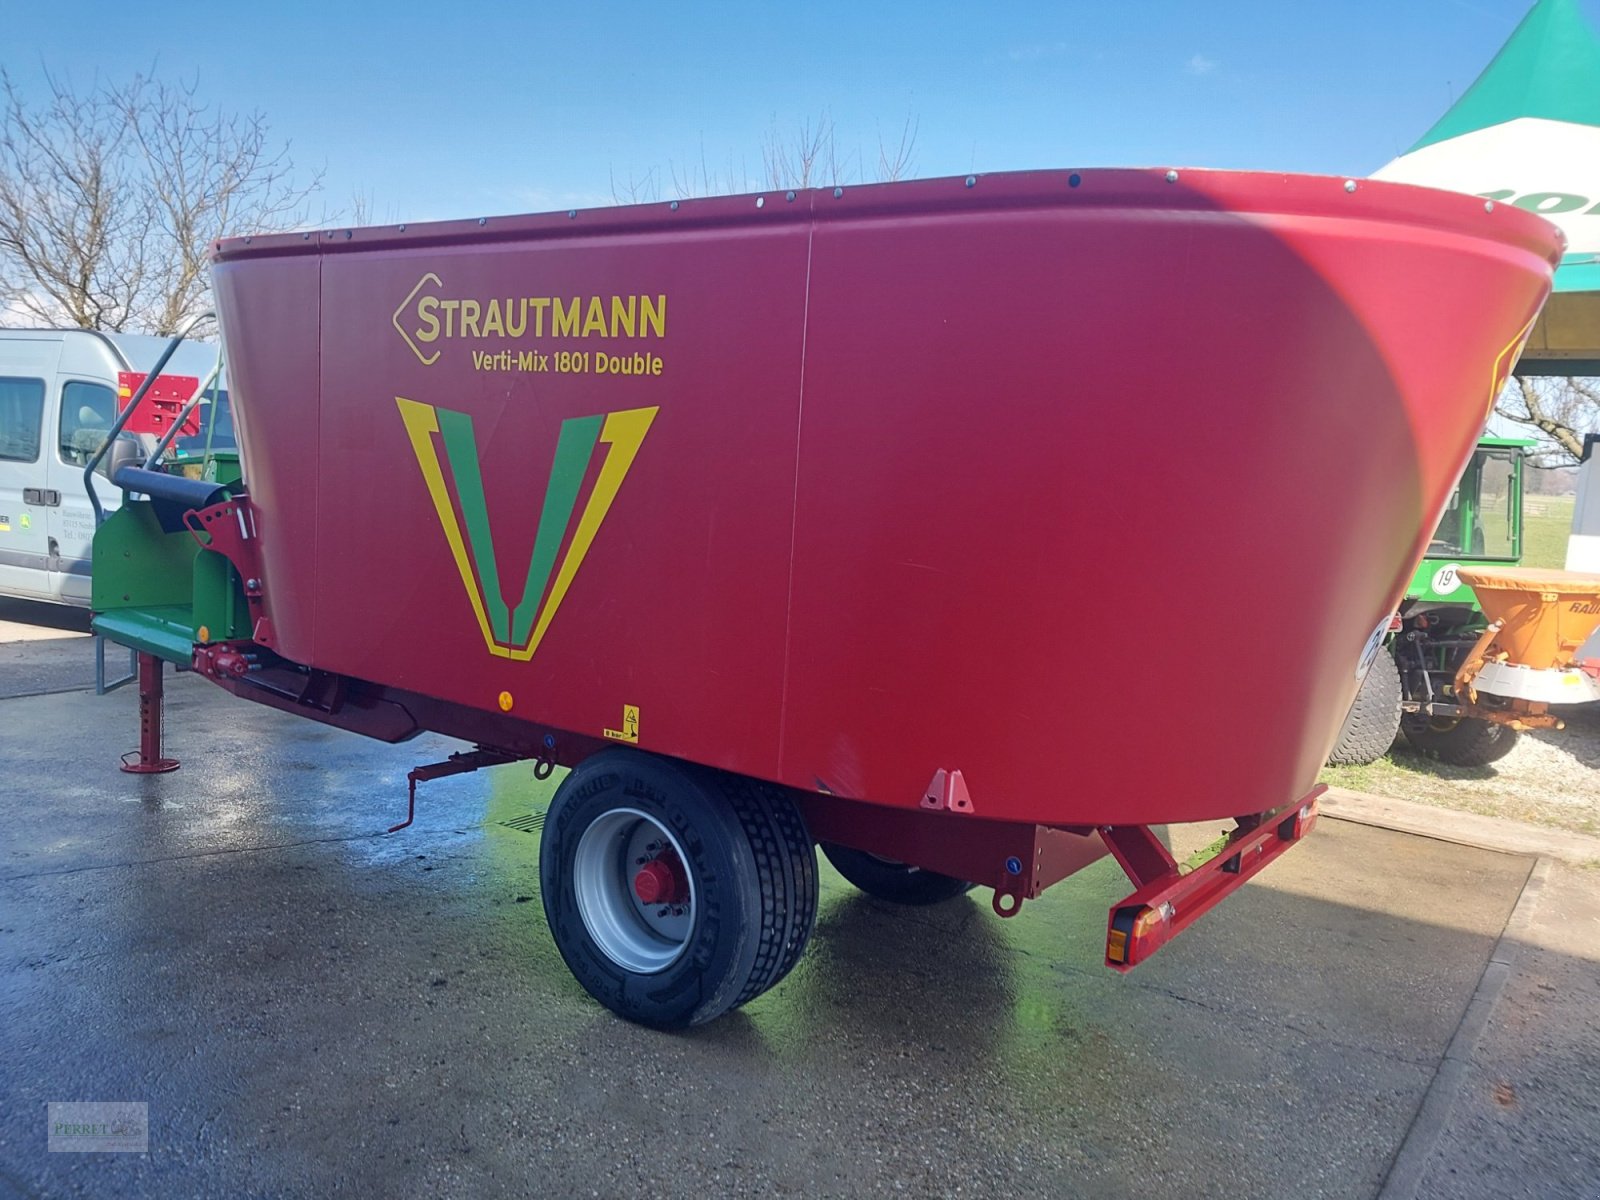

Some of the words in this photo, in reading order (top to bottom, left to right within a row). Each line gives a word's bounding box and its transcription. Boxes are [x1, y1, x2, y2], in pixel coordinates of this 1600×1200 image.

[415, 295, 667, 342] STRAUTMANN
[472, 349, 549, 372] Verti-Mix
[553, 351, 589, 373] 1801
[595, 352, 664, 375] Double
[1437, 569, 1454, 587] 19
